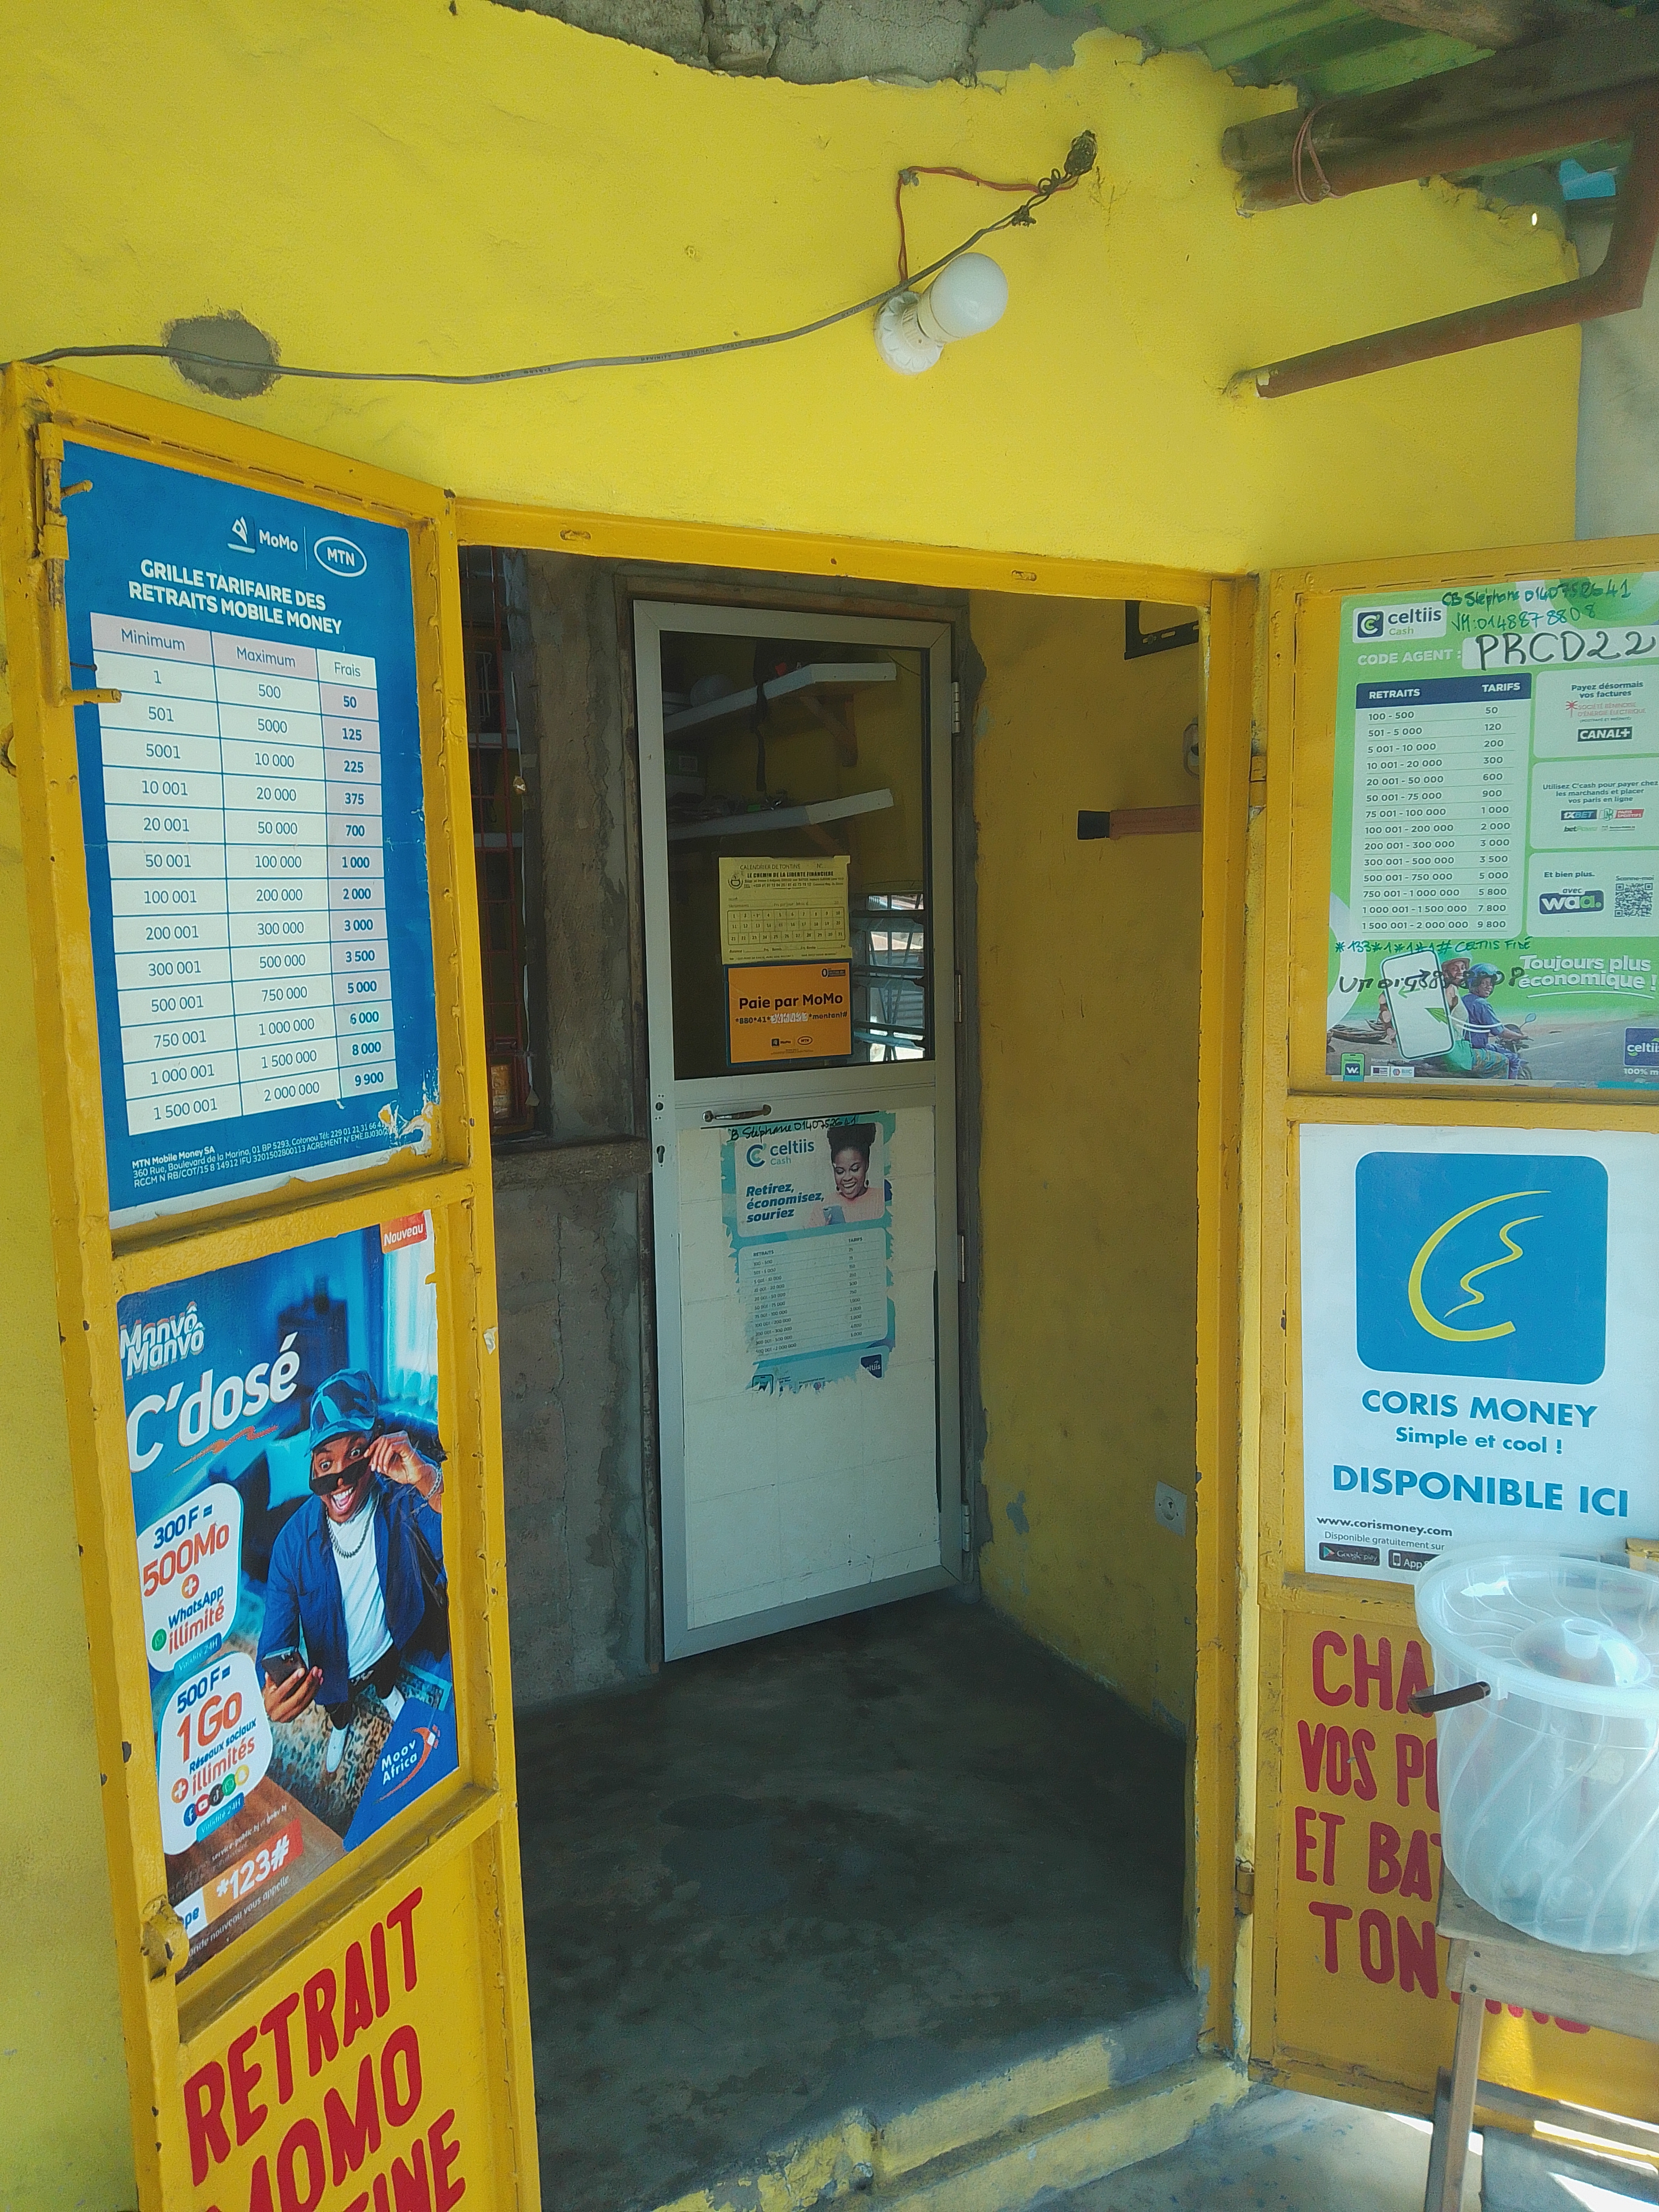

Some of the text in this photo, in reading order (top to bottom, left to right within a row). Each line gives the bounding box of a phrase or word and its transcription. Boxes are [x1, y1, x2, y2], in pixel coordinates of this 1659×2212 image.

[259, 529, 298, 552] MoMo
[328, 547, 354, 566] MTN
[141, 559, 325, 610] GRILLE TARIFAIRE DES
[129, 581, 341, 635] RETRAITS MOBILE MONEY
[1442, 592, 1462, 607] CB
[1388, 607, 1442, 624] celtiis
[1389, 626, 1413, 635] Cash
[121, 629, 361, 677] Minimum Maximum Frais
[1358, 649, 1453, 665] CODE AGENT
[154, 671, 357, 709] 1 500 50
[1369, 682, 1520, 699] RETRAITS TARIFS
[1599, 681, 1644, 690] désormais
[148, 707, 362, 741] 501 5000 125
[1580, 728, 1630, 740] CANAL+
[146, 744, 363, 773] 5001 225
[345, 793, 364, 805] 375
[346, 825, 364, 836] 700
[1520, 954, 1651, 973] Toujours plus
[1518, 970, 1645, 990] économique
[739, 993, 843, 1010] Paie par MoMo
[132, 1146, 215, 1169] MTN Mobile Money SA
[133, 1168, 148, 1179] 360
[168, 1157, 206, 1170] Boulevard
[292, 1134, 318, 1146] Cotonou
[217, 1160, 238, 1170] 14912
[240, 1155, 251, 1164] IFU
[307, 1138, 342, 1150] AGREMENT
[770, 1139, 815, 1156] celtiis
[770, 1156, 791, 1165] Cash
[746, 1183, 794, 1197] Retirez,
[747, 1192, 824, 1209] économisez,
[747, 1208, 794, 1222] souriez
[383, 1224, 423, 1246] Nouveau
[126, 1332, 300, 1472] C'dosé
[1362, 1389, 1598, 1428] CORIS MONEY
[1395, 1426, 1467, 1449] Simple
[1474, 1434, 1496, 1449] et
[1503, 1435, 1547, 1454] cool
[1333, 1463, 1629, 1518] DISPONIBLE ICI
[1317, 1517, 1452, 1537] www.corismoney.com
[1325, 1531, 1370, 1543] Disponible
[1372, 1537, 1429, 1549] gratuitement
[143, 1522, 229, 1597] 500Mo
[1404, 1558, 1422, 1570] App
[168, 1585, 224, 1629] WhatsApp
[169, 1598, 224, 1655] illimité
[1312, 1630, 1435, 1717] CHA
[189, 1717, 256, 1774] Réseaux sociaux
[380, 1739, 416, 1772] Moov
[192, 1737, 255, 1796] illimités
[382, 1752, 417, 1784] Africa
[1298, 1720, 1378, 1800] VOS
[1295, 1806, 1346, 1886] ET
[211, 1912, 242, 1942] nouveau
[244, 1898, 261, 1915] vous
[1308, 1901, 1439, 2000] TON
[183, 1886, 423, 2187] RETRAIT
[206, 2025, 422, 2212] OMO
